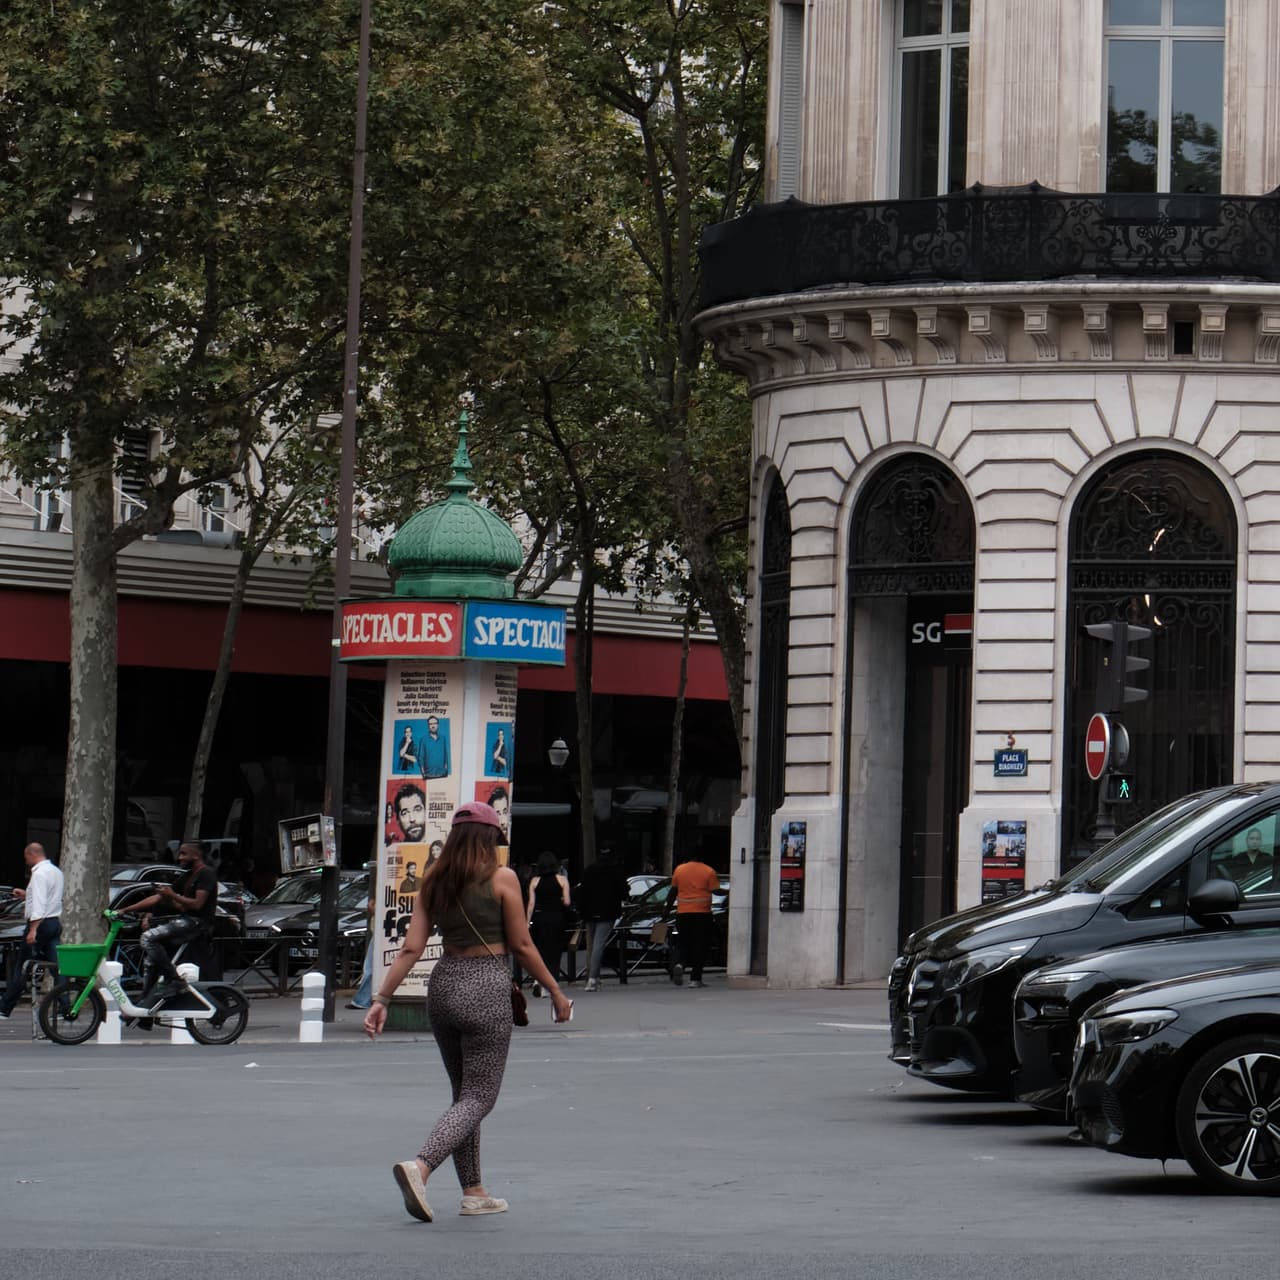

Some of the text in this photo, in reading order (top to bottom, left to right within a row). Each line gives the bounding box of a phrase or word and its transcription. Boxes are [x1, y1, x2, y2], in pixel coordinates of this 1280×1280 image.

[342, 612, 453, 644] SPECTACLES
[911, 622, 941, 643] SG
[385, 885, 397, 908] Un
[398, 895, 416, 914] su
